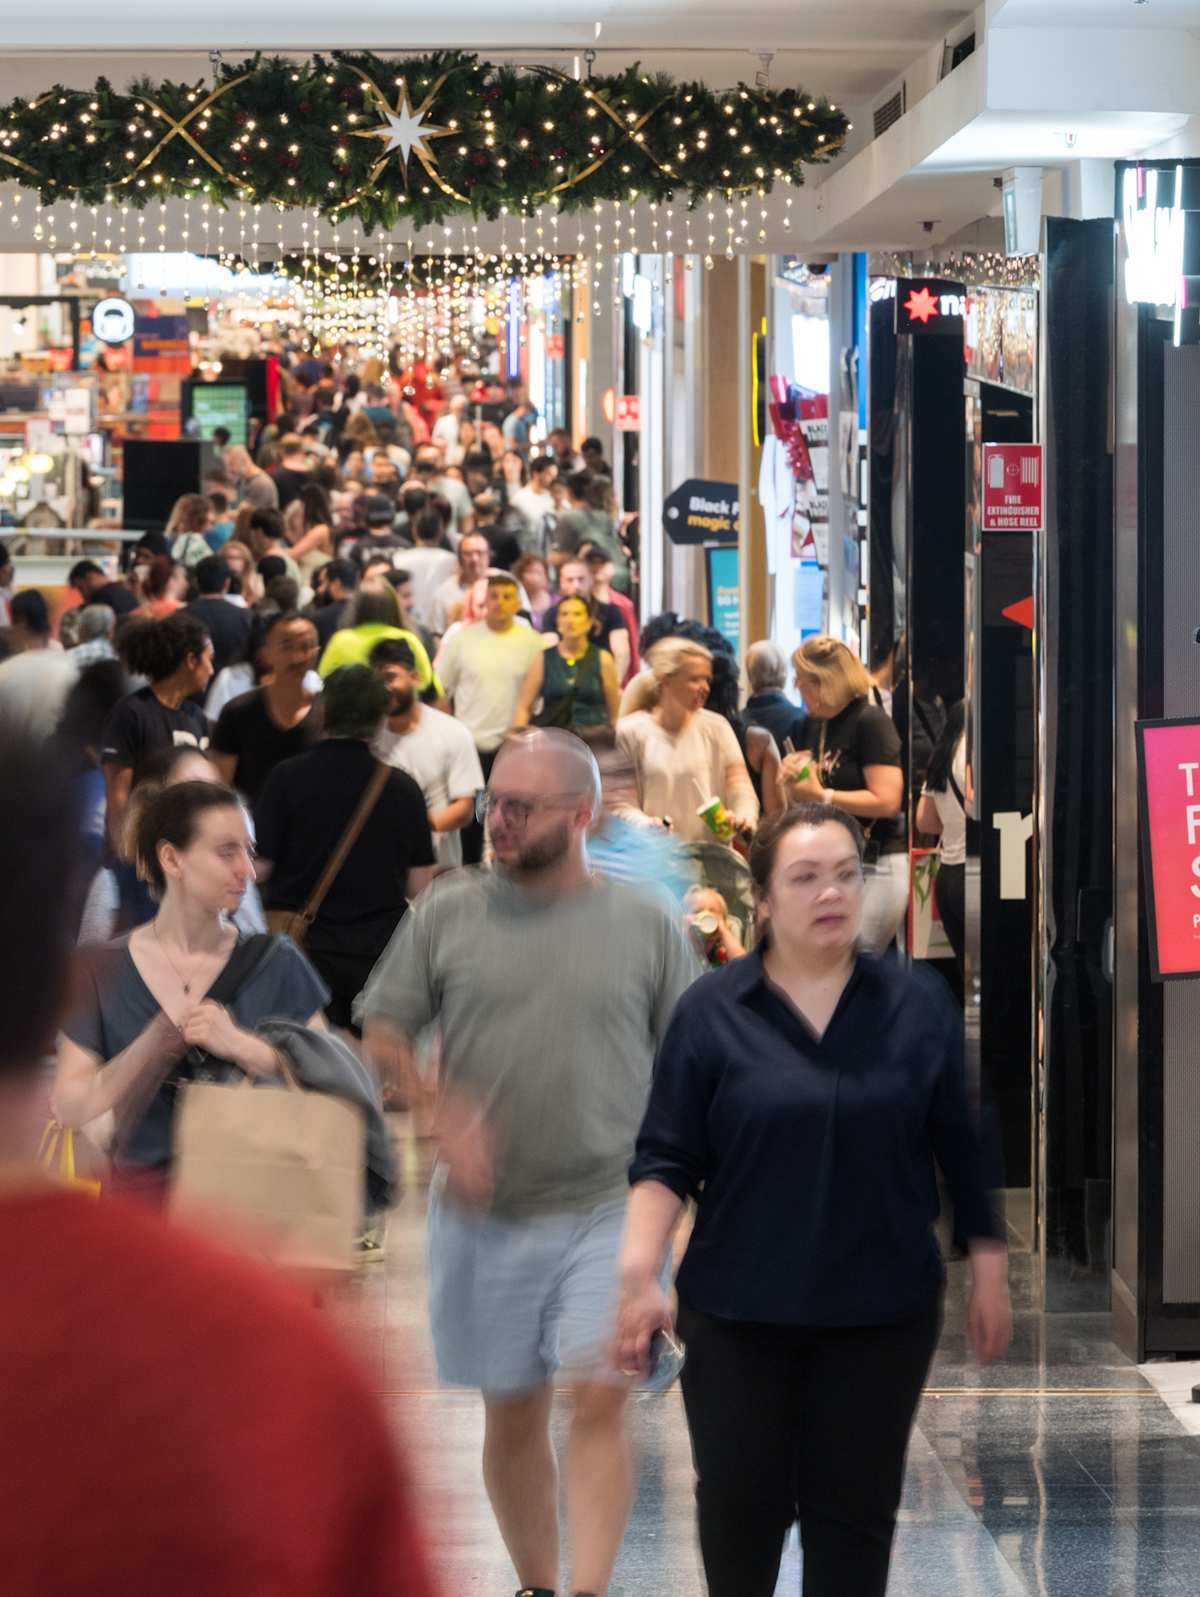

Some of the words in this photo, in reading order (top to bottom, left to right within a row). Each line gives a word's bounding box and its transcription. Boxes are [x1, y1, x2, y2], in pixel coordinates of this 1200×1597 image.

[1004, 495, 1021, 505] FIRE
[689, 496, 730, 515] Black
[987, 506, 1039, 516] EXTINGUISHER
[687, 514, 730, 532] magic
[997, 517, 1018, 527] HOSE
[1019, 517, 1038, 527] REEL
